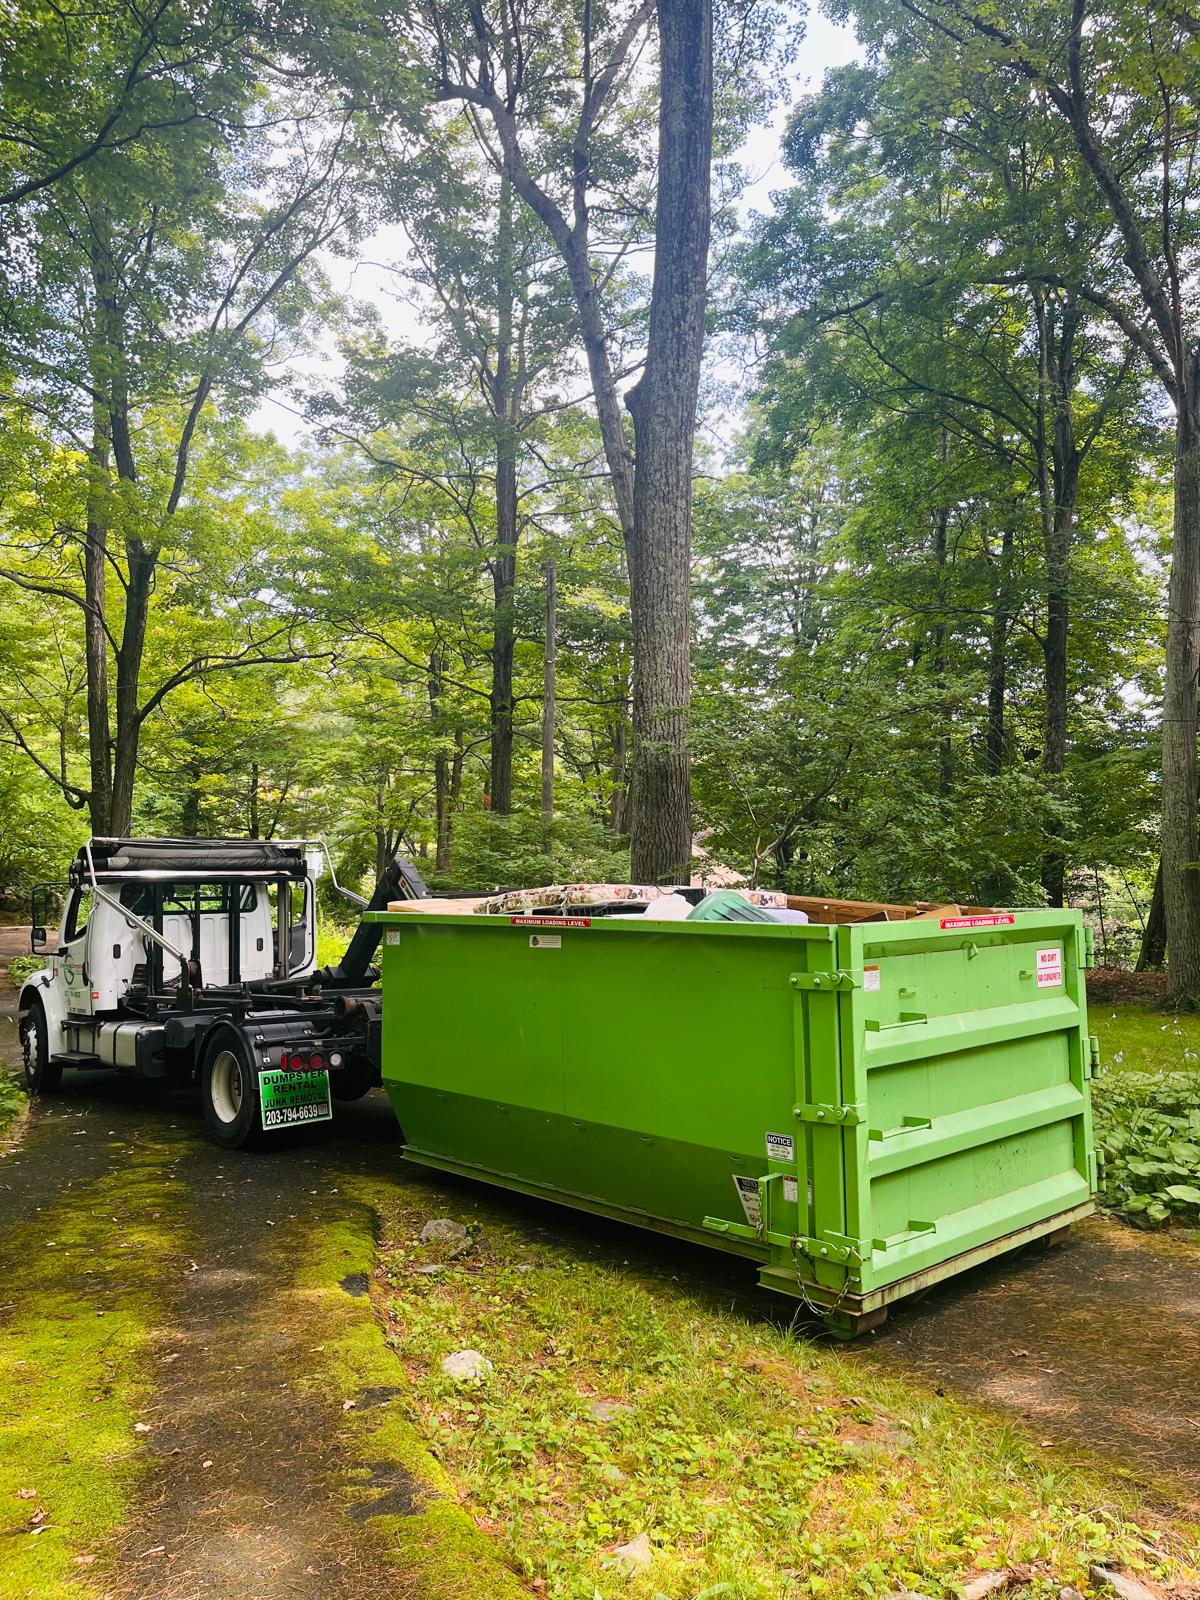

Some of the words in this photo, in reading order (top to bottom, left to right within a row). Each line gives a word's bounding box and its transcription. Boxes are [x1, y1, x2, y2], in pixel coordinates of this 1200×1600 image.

[945, 920, 971, 928] MAXIMUM
[1040, 954, 1047, 963] NO
[263, 1070, 325, 1086] DUMPSTER
[273, 1080, 317, 1094] RENTAL
[264, 1097, 288, 1109] JUNK
[290, 1091, 328, 1105] REMOVAL
[266, 1104, 318, 1125] 203-794-6639
[768, 1135, 791, 1146] NOTICE
